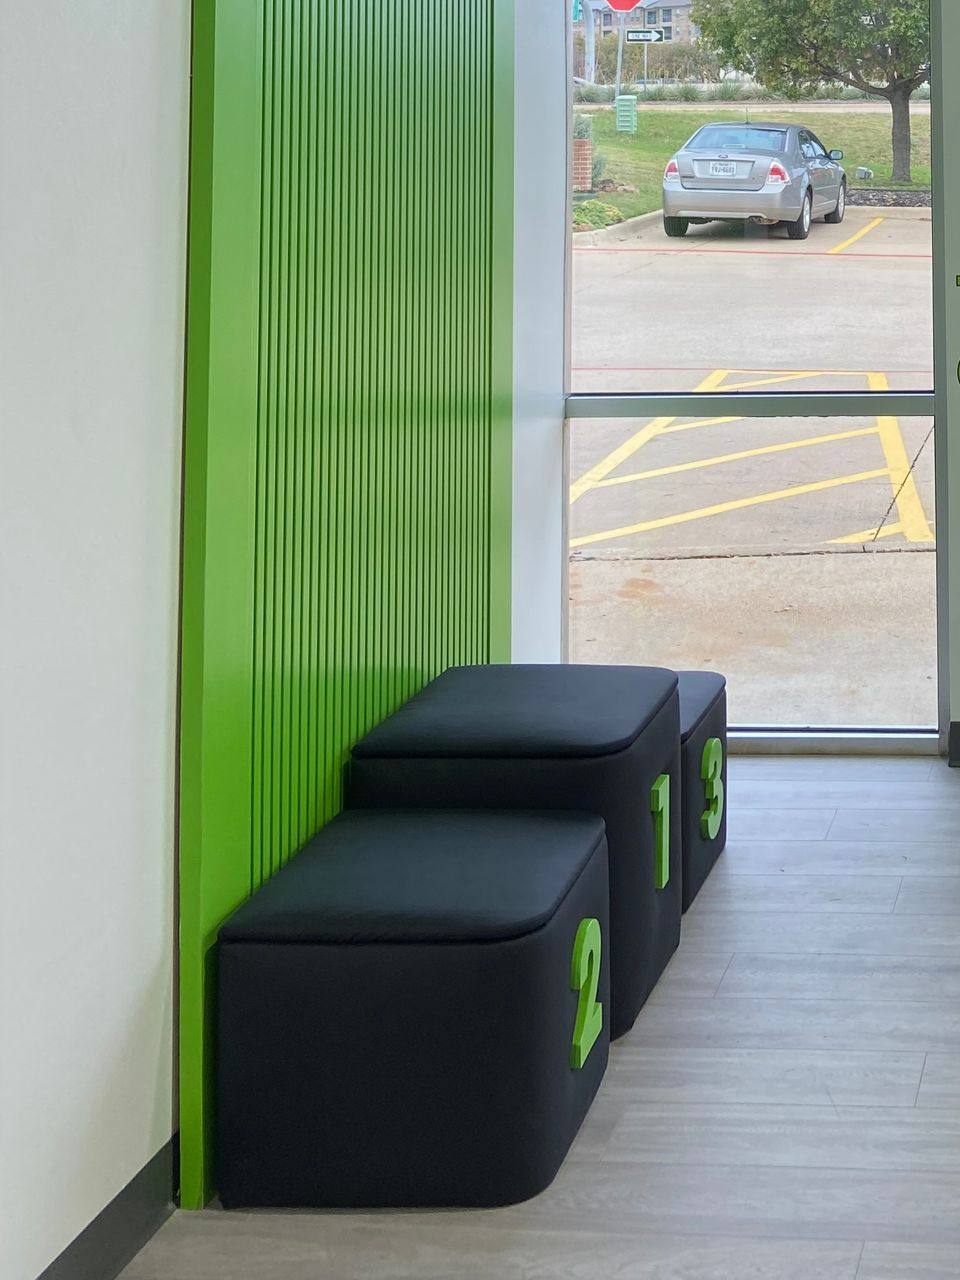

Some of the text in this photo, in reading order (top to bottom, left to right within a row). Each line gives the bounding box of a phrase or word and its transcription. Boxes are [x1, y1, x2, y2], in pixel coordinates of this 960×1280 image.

[651, 775, 669, 889] 1
[701, 738, 724, 840] 3
[571, 918, 603, 1069] 2
